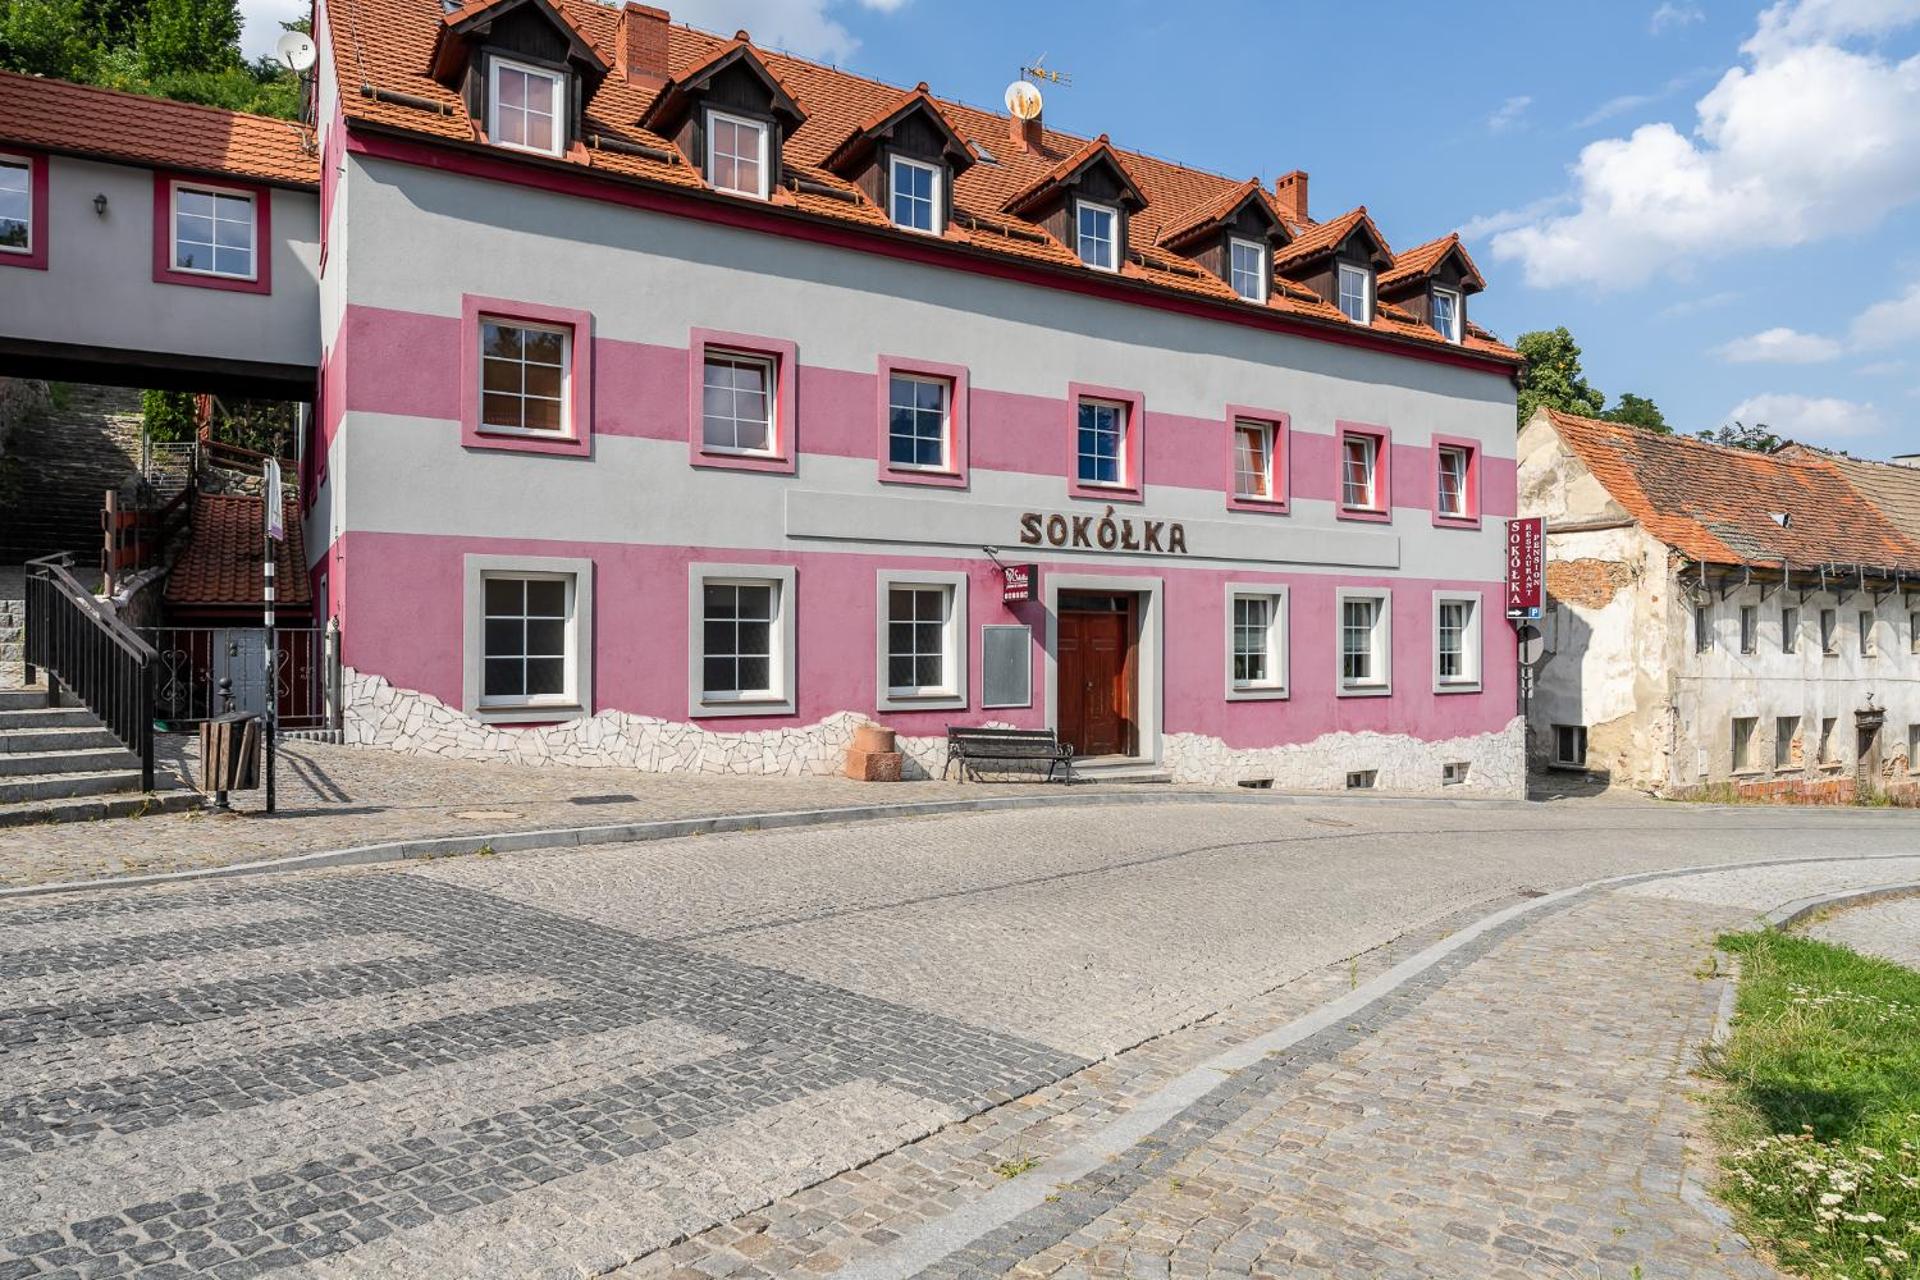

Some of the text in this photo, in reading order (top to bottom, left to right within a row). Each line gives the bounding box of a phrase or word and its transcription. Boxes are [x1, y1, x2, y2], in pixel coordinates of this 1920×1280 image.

[1020, 505, 1188, 554] SOKÓŁKA
[1510, 521, 1521, 604] SOKÓŁKA
[1525, 523, 1533, 597] RESTAURANT
